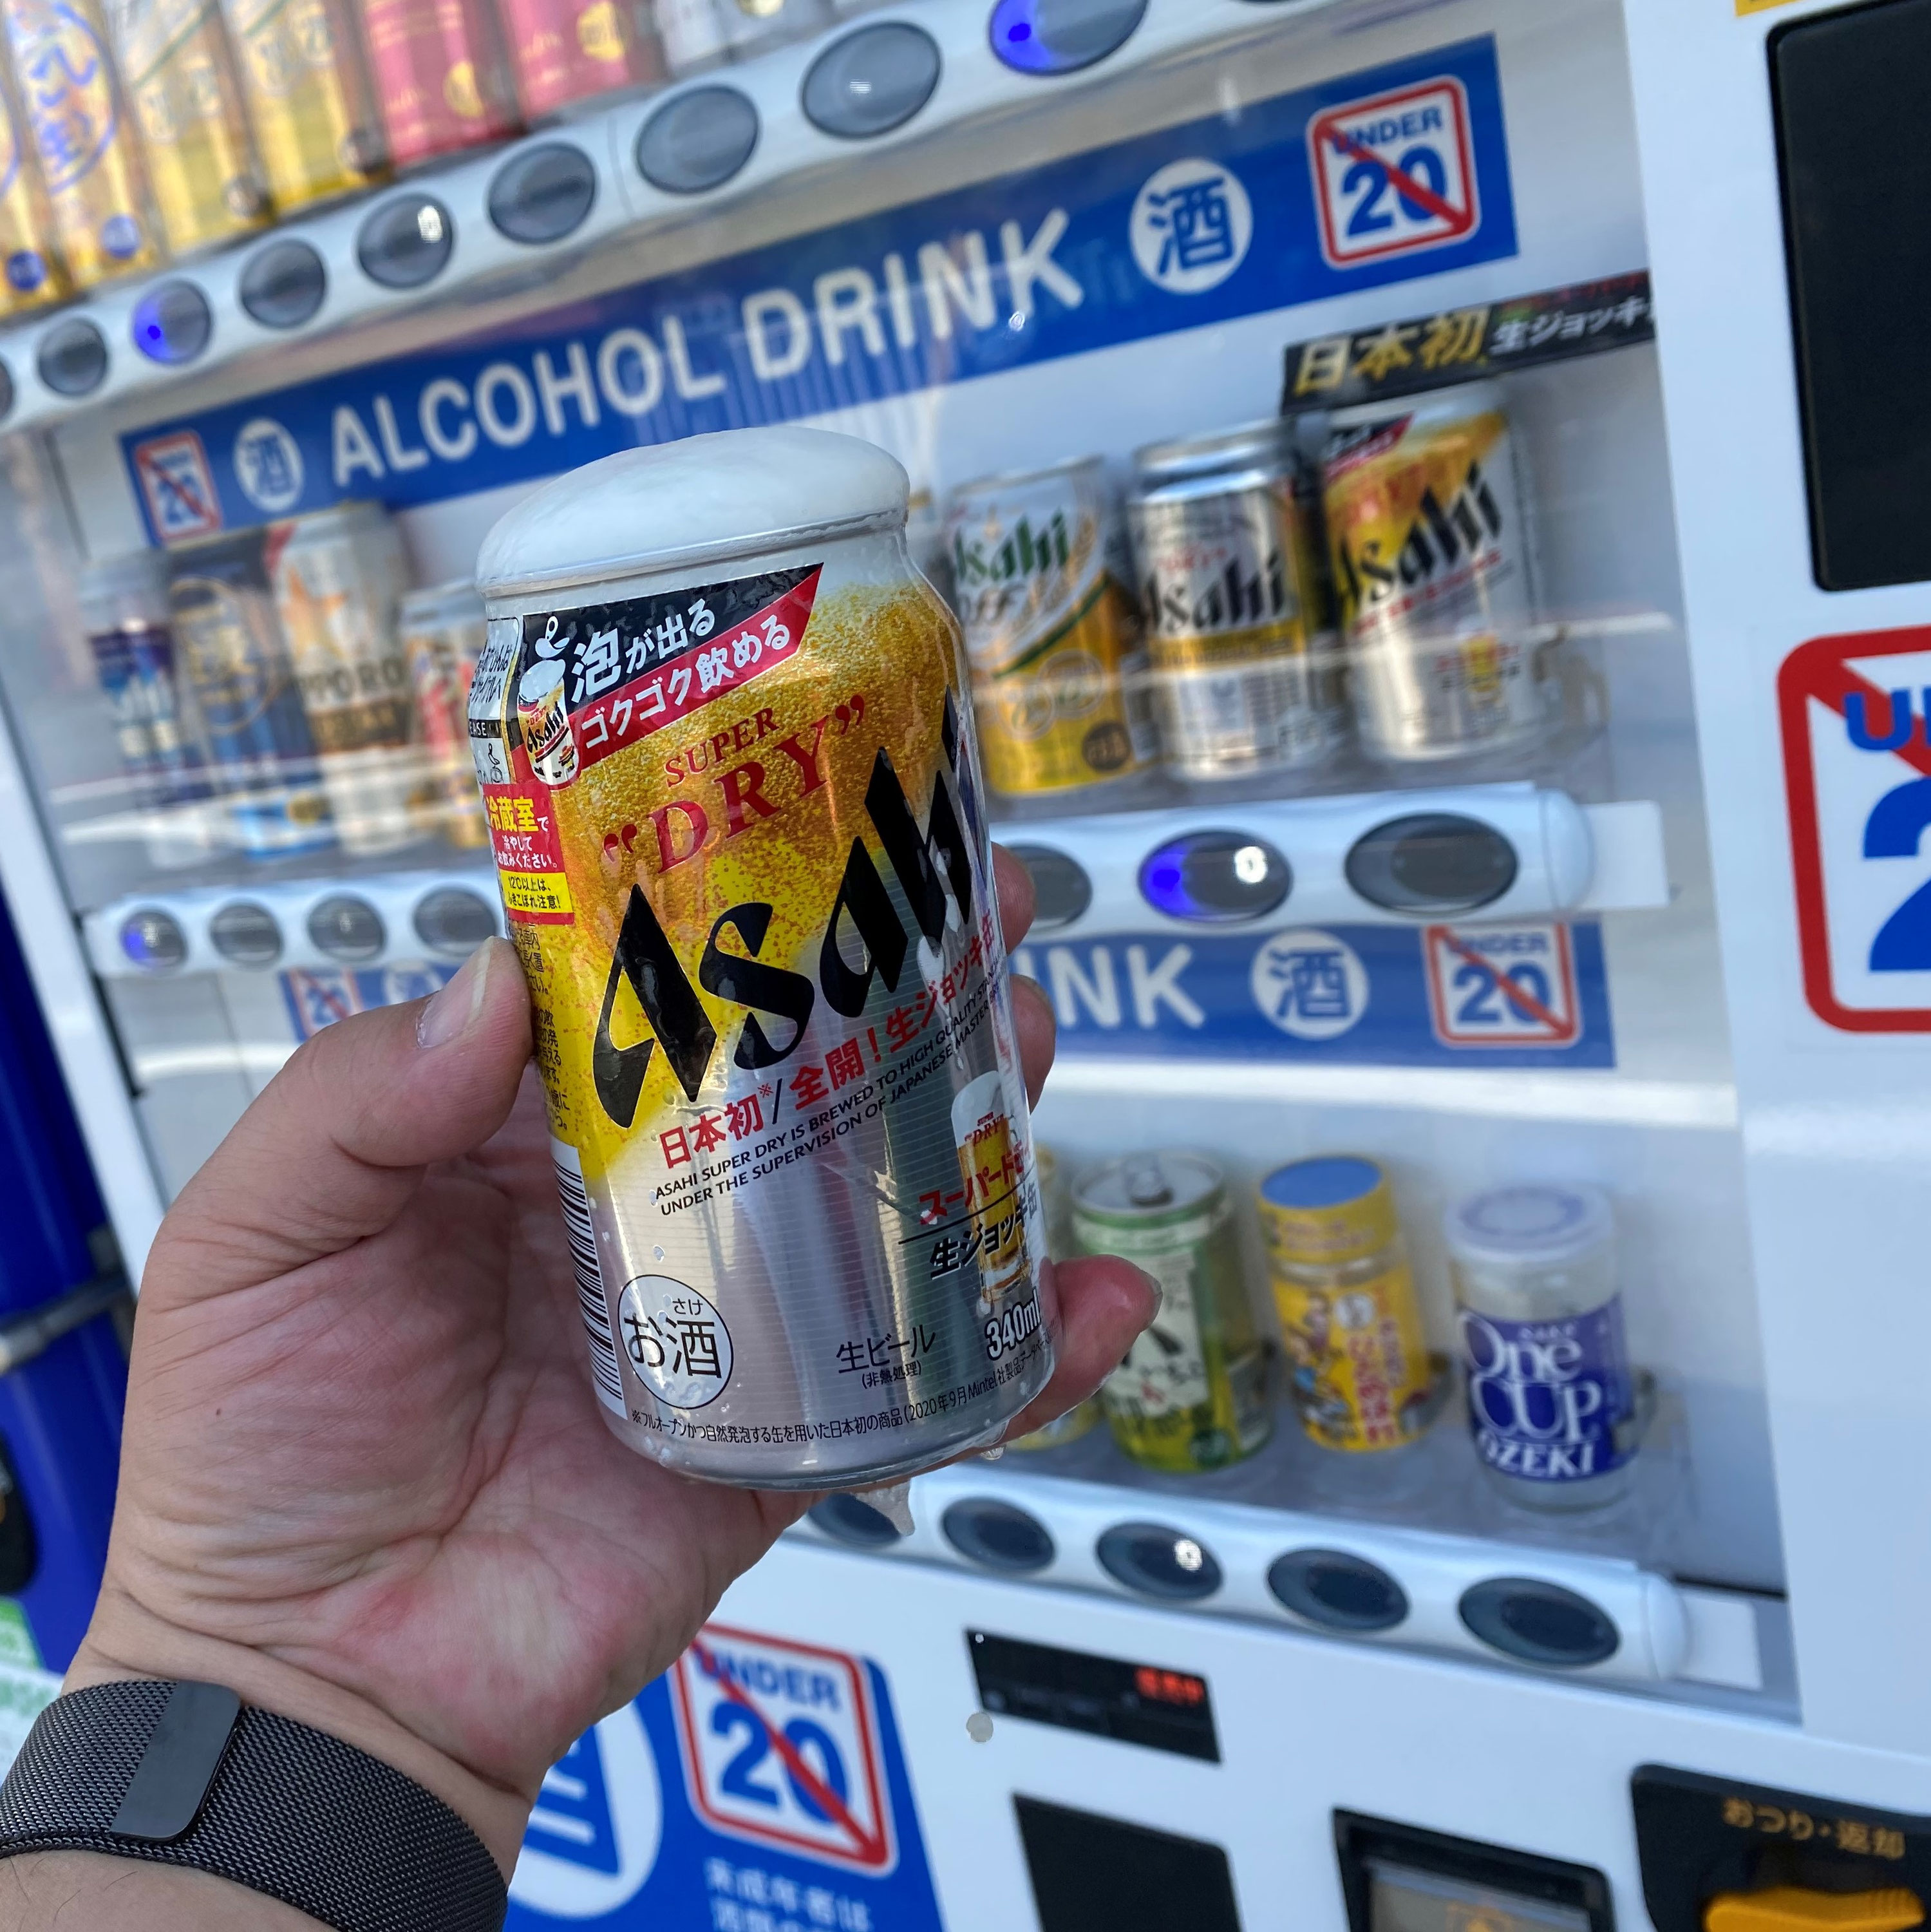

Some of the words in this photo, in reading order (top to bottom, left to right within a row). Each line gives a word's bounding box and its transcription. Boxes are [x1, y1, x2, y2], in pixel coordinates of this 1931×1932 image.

[1331, 106, 1444, 155] UNDER
[1147, 176, 1235, 276] 酒
[1341, 146, 1447, 238] 20
[332, 314, 725, 488] ALCOHOL
[741, 207, 1084, 380] DRINK
[1489, 291, 1653, 357] 生ジョッキ
[571, 598, 715, 703] 泡が出る
[582, 614, 790, 749] ゴクゴク飲める
[664, 707, 780, 789] SUPER
[486, 795, 549, 832] 冷蔵室で
[593, 684, 988, 1128] Asahi
[1257, 943, 1353, 1022] 酒
[1453, 961, 1550, 1025] 20
[655, 1173, 697, 1200] ASAHI
[702, 1151, 751, 1182] SUPER
[755, 1132, 787, 1159] DRY
[791, 1124, 805, 1141] IS
[809, 1085, 874, 1132] BREWED
[876, 1069, 897, 1090] TO
[900, 1040, 934, 1075] HIGH
[936, 996, 977, 1046] QUALITY
[661, 1186, 713, 1216] UNDER
[716, 1172, 749, 1195] THE
[753, 1114, 862, 1180] SUPERVISION
[865, 1095, 887, 1119] OF
[890, 1042, 954, 1104] JAPANESE
[956, 1003, 990, 1049] MASTER
[624, 1312, 723, 1379] お酒
[672, 1297, 704, 1316] さけ
[984, 1288, 1043, 1361] 340ml
[836, 1324, 937, 1374] 生ビール
[862, 1360, 922, 1390] (非熱処理)
[1458, 1311, 1583, 1383] One
[711, 1699, 849, 1824] 20
